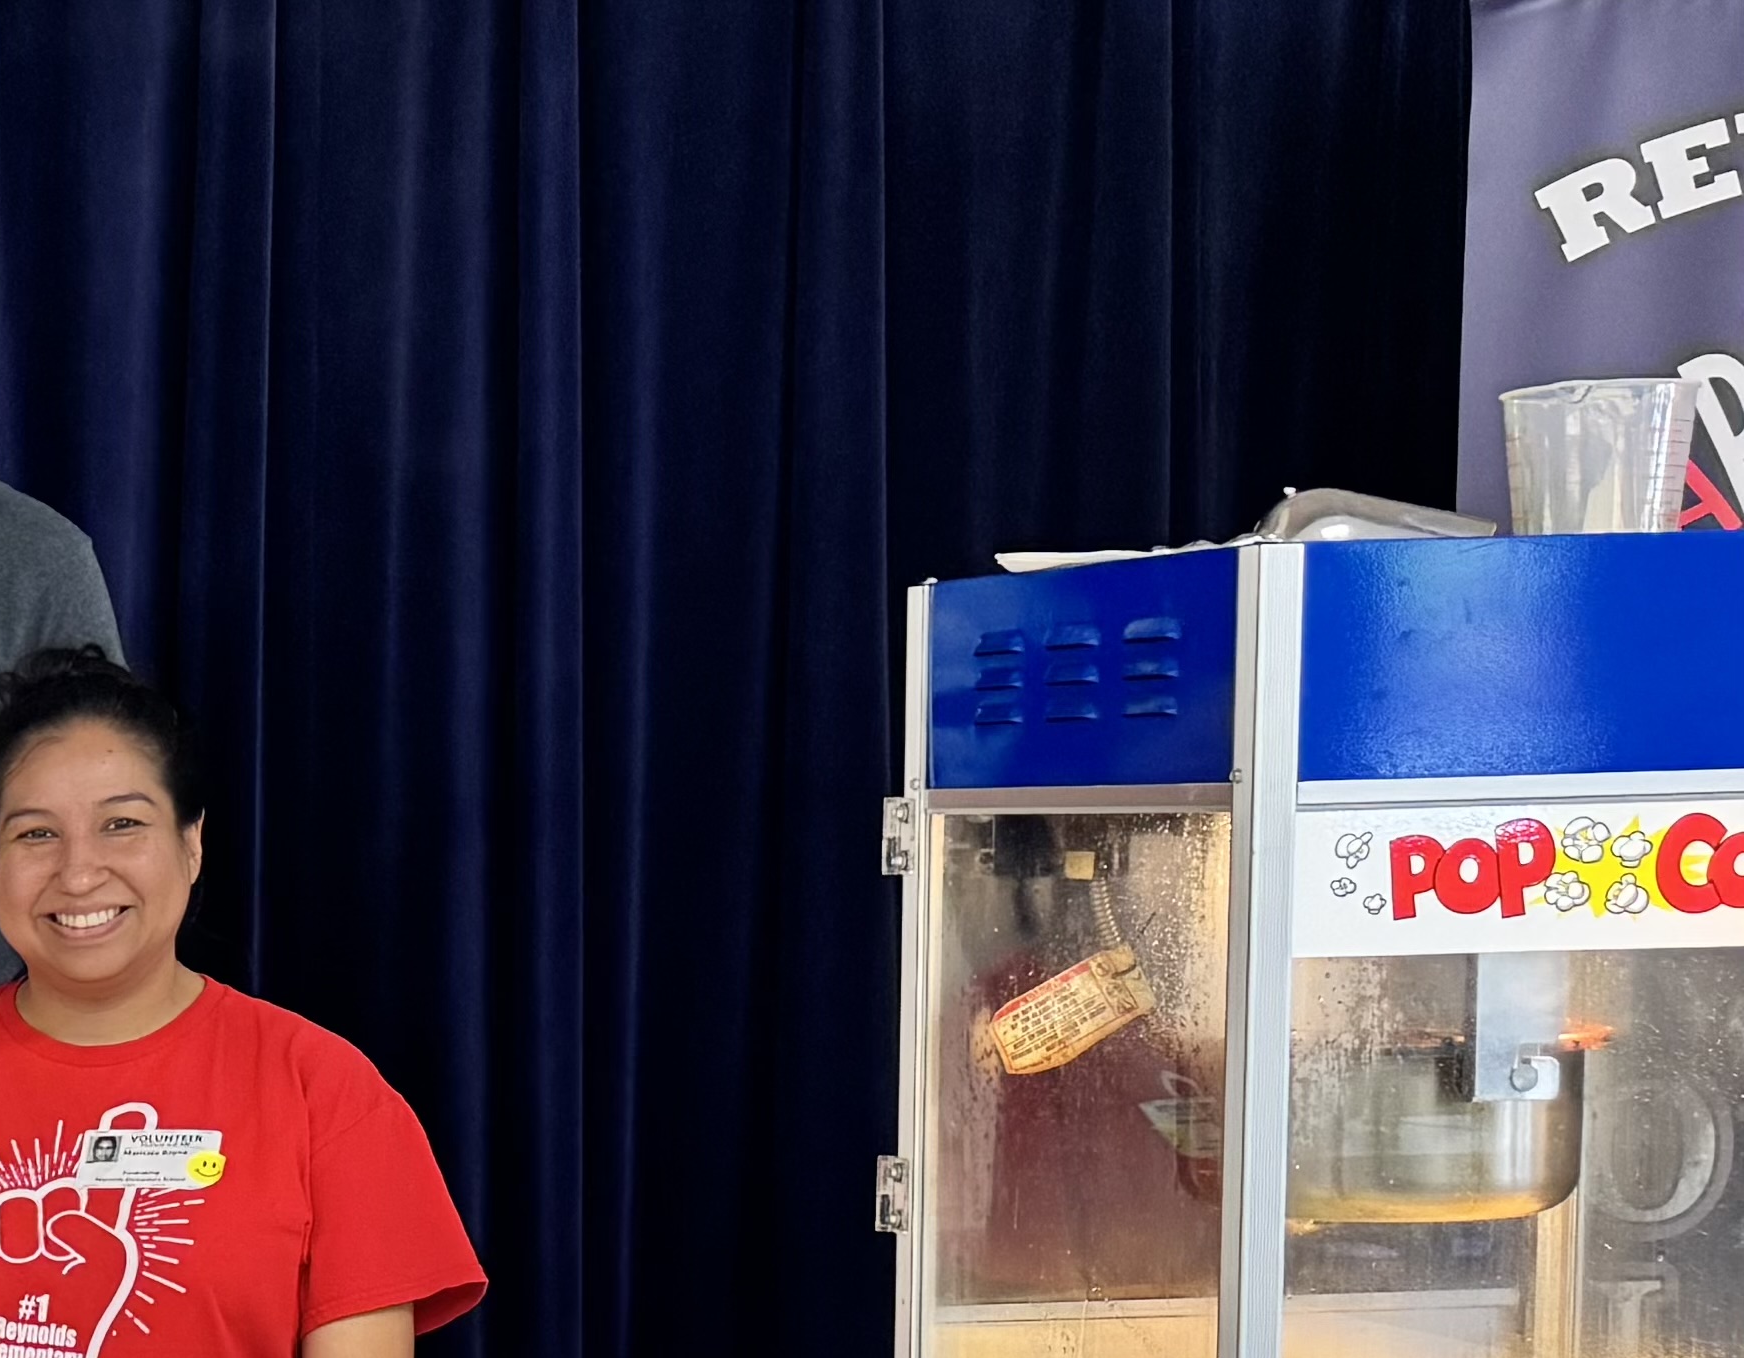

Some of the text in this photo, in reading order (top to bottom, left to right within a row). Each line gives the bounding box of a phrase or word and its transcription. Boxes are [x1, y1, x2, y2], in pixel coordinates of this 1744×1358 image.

[1389, 817, 1556, 921] POP
[131, 1134, 203, 1144] VOLUNTEER
[18, 1293, 50, 1322] #1
